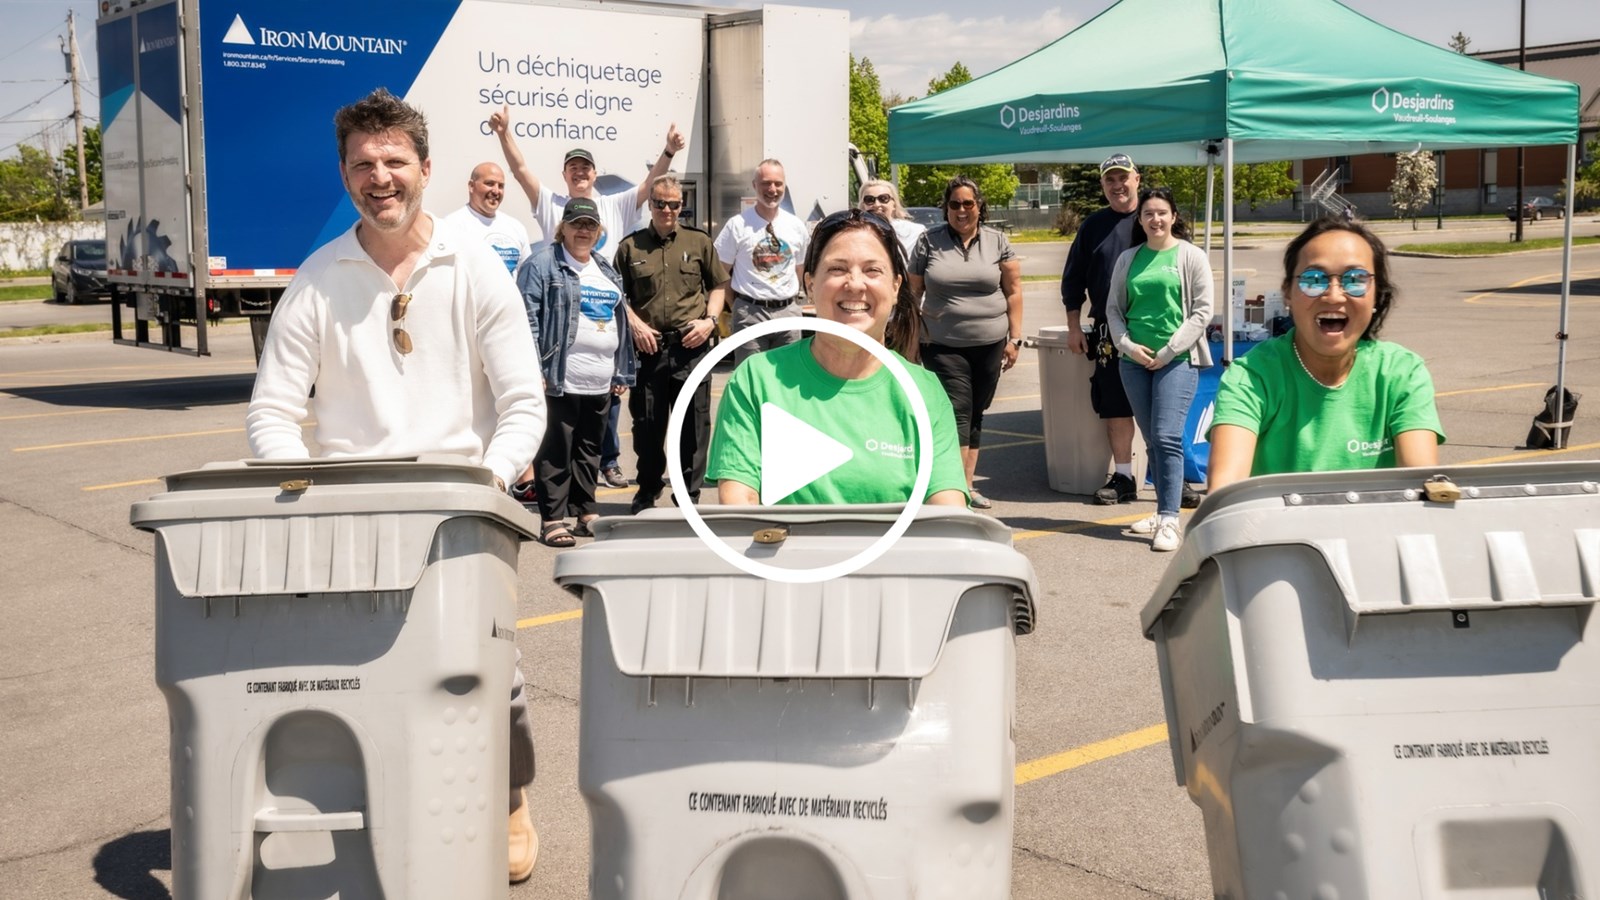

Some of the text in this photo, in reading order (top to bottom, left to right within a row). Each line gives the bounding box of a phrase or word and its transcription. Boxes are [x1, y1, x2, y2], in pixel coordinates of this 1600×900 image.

[259, 27, 305, 49] IRON
[223, 61, 267, 69] 1.800.327.8345
[478, 50, 662, 88] Un déchiquetage
[479, 83, 633, 116] sécurisé digne
[1393, 91, 1454, 113] Desjardins
[1018, 103, 1080, 124] Desjardins
[1393, 113, 1456, 125] Vaudreuil-Soulanges
[514, 118, 618, 141] confiance
[1019, 123, 1082, 136] Vaudreuil-Soulanges
[246, 682, 252, 694] CE
[310, 680, 316, 692] DE
[688, 791, 888, 820] CE CONTENANT FABRIQUÉ AVEC DE MATÉRIAUX RECYCLÉS
